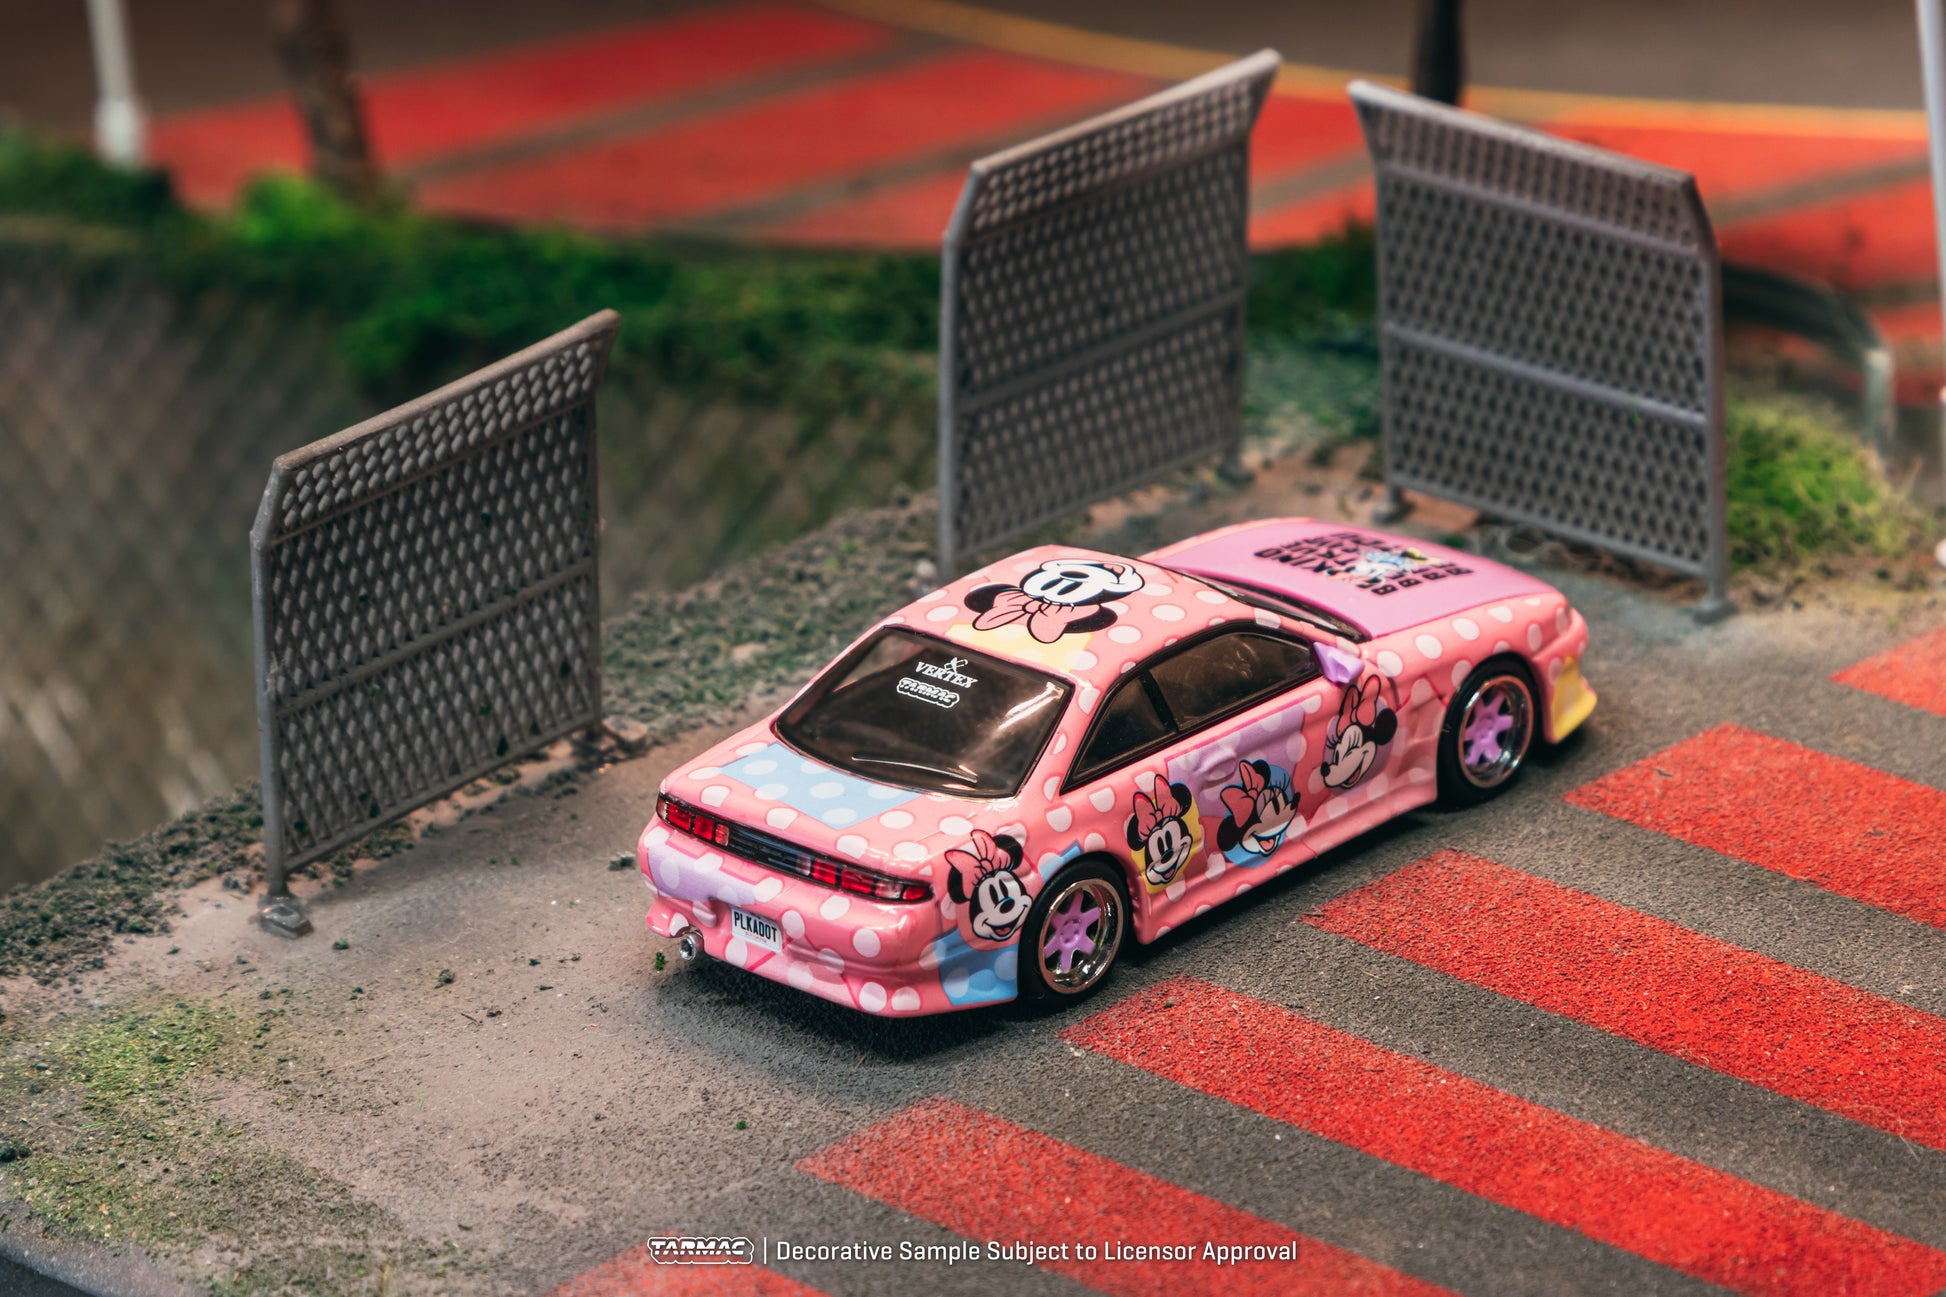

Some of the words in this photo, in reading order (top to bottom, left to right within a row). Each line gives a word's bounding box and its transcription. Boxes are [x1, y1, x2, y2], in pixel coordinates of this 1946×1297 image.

[915, 661, 978, 688] VERTEX
[898, 677, 959, 706] TARMAC
[734, 911, 778, 942] PLKADOT
